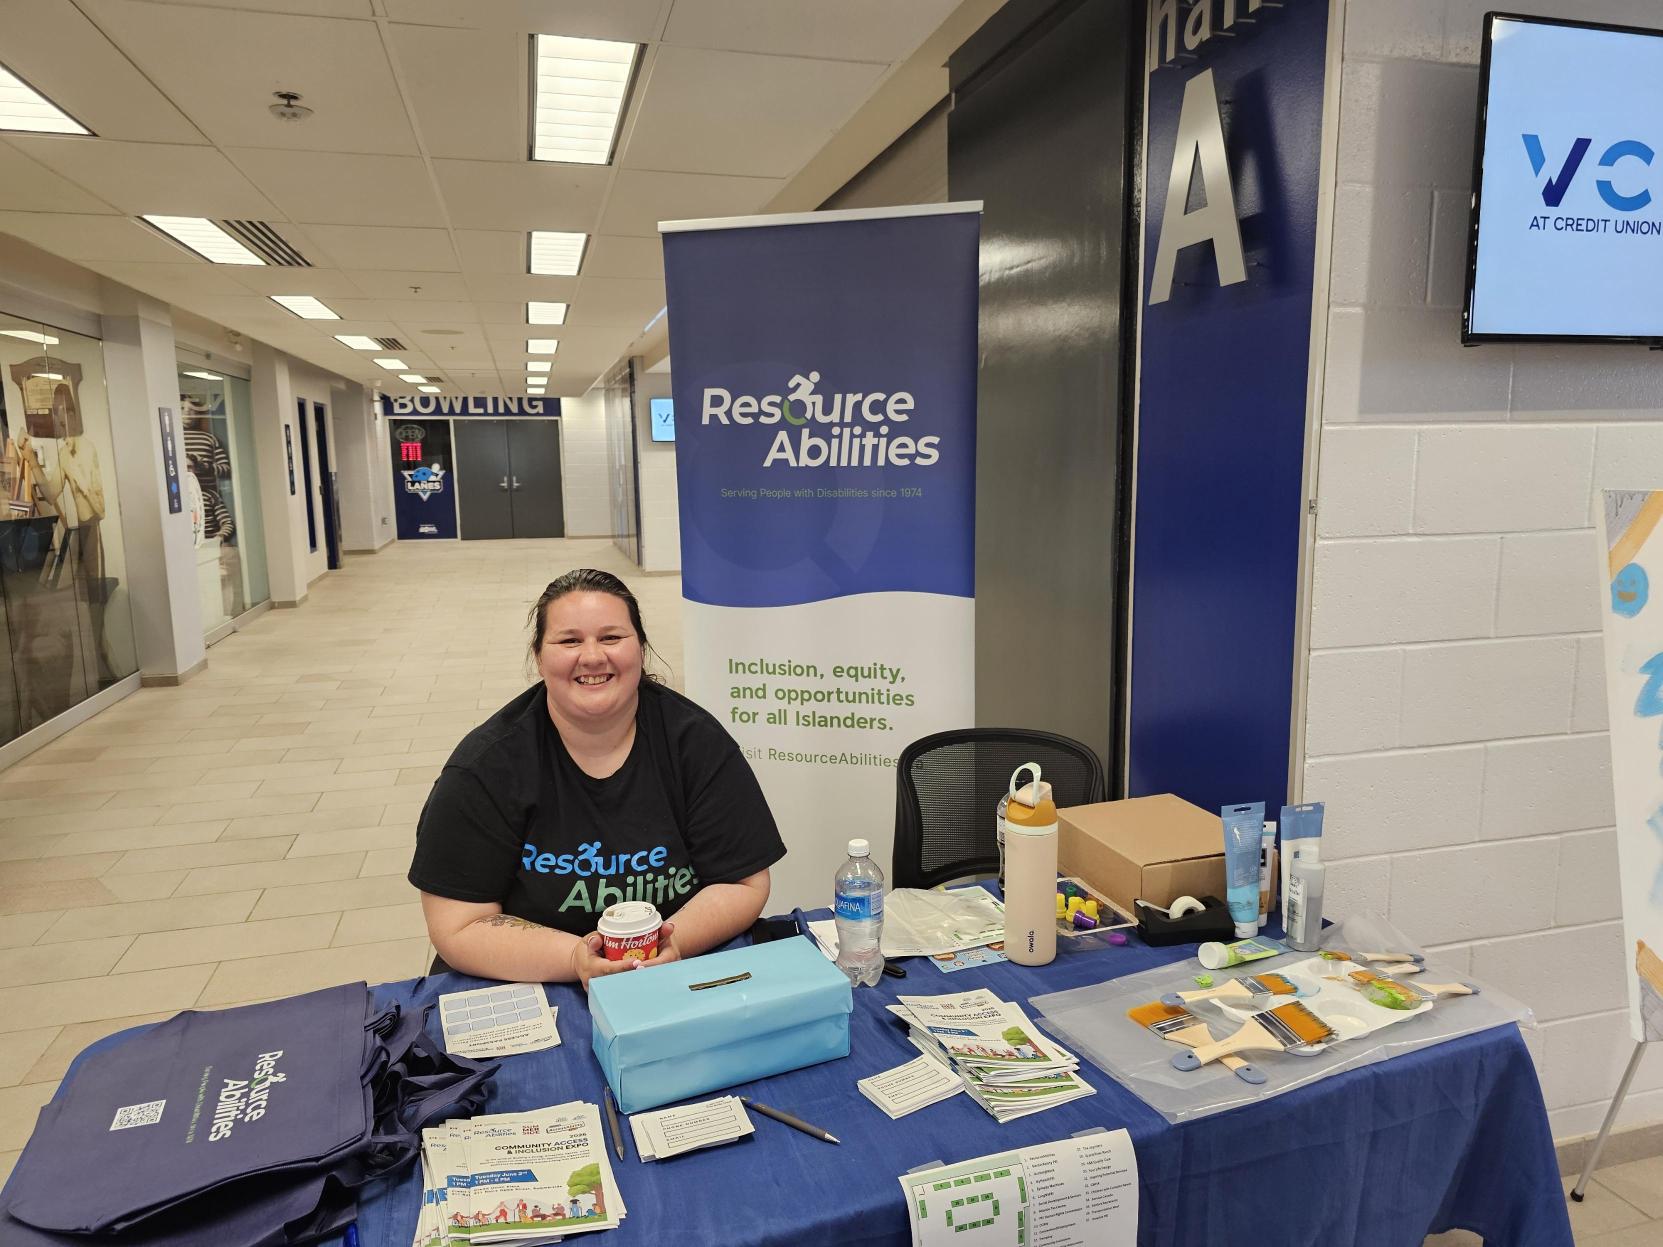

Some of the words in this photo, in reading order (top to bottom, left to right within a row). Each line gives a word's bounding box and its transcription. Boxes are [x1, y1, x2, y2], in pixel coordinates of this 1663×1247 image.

[1149, 67, 1248, 305] A
[1529, 216, 1550, 231] AT
[1554, 217, 1611, 233] CREDIT
[1614, 219, 1662, 236] UNION
[392, 395, 545, 414] BOWLING
[701, 384, 915, 426] Resource
[762, 425, 942, 468] Abilities
[407, 481, 441, 491] LANES
[720, 488, 757, 500] Serving
[759, 488, 791, 500] People
[794, 488, 814, 498] with
[817, 488, 869, 498] Disabilities
[871, 488, 897, 498] since
[901, 487, 922, 497] 1974
[728, 658, 825, 680] Inclusion,
[832, 663, 906, 685] equity,
[730, 683, 767, 700] and
[774, 687, 915, 707] opportunities
[730, 707, 759, 724] for
[766, 709, 788, 726] all
[795, 710, 894, 731] Islanders.
[522, 842, 668, 877] Resource
[1027, 930, 1035, 953] owala
[245, 1050, 286, 1123] Resource
[208, 1079, 249, 1142] Abilities
[495, 1142, 552, 1151] COMMUNITY
[554, 1138, 589, 1146] ACCESS
[515, 1146, 564, 1154] INCLUSION
[565, 1142, 589, 1150] EXPO
